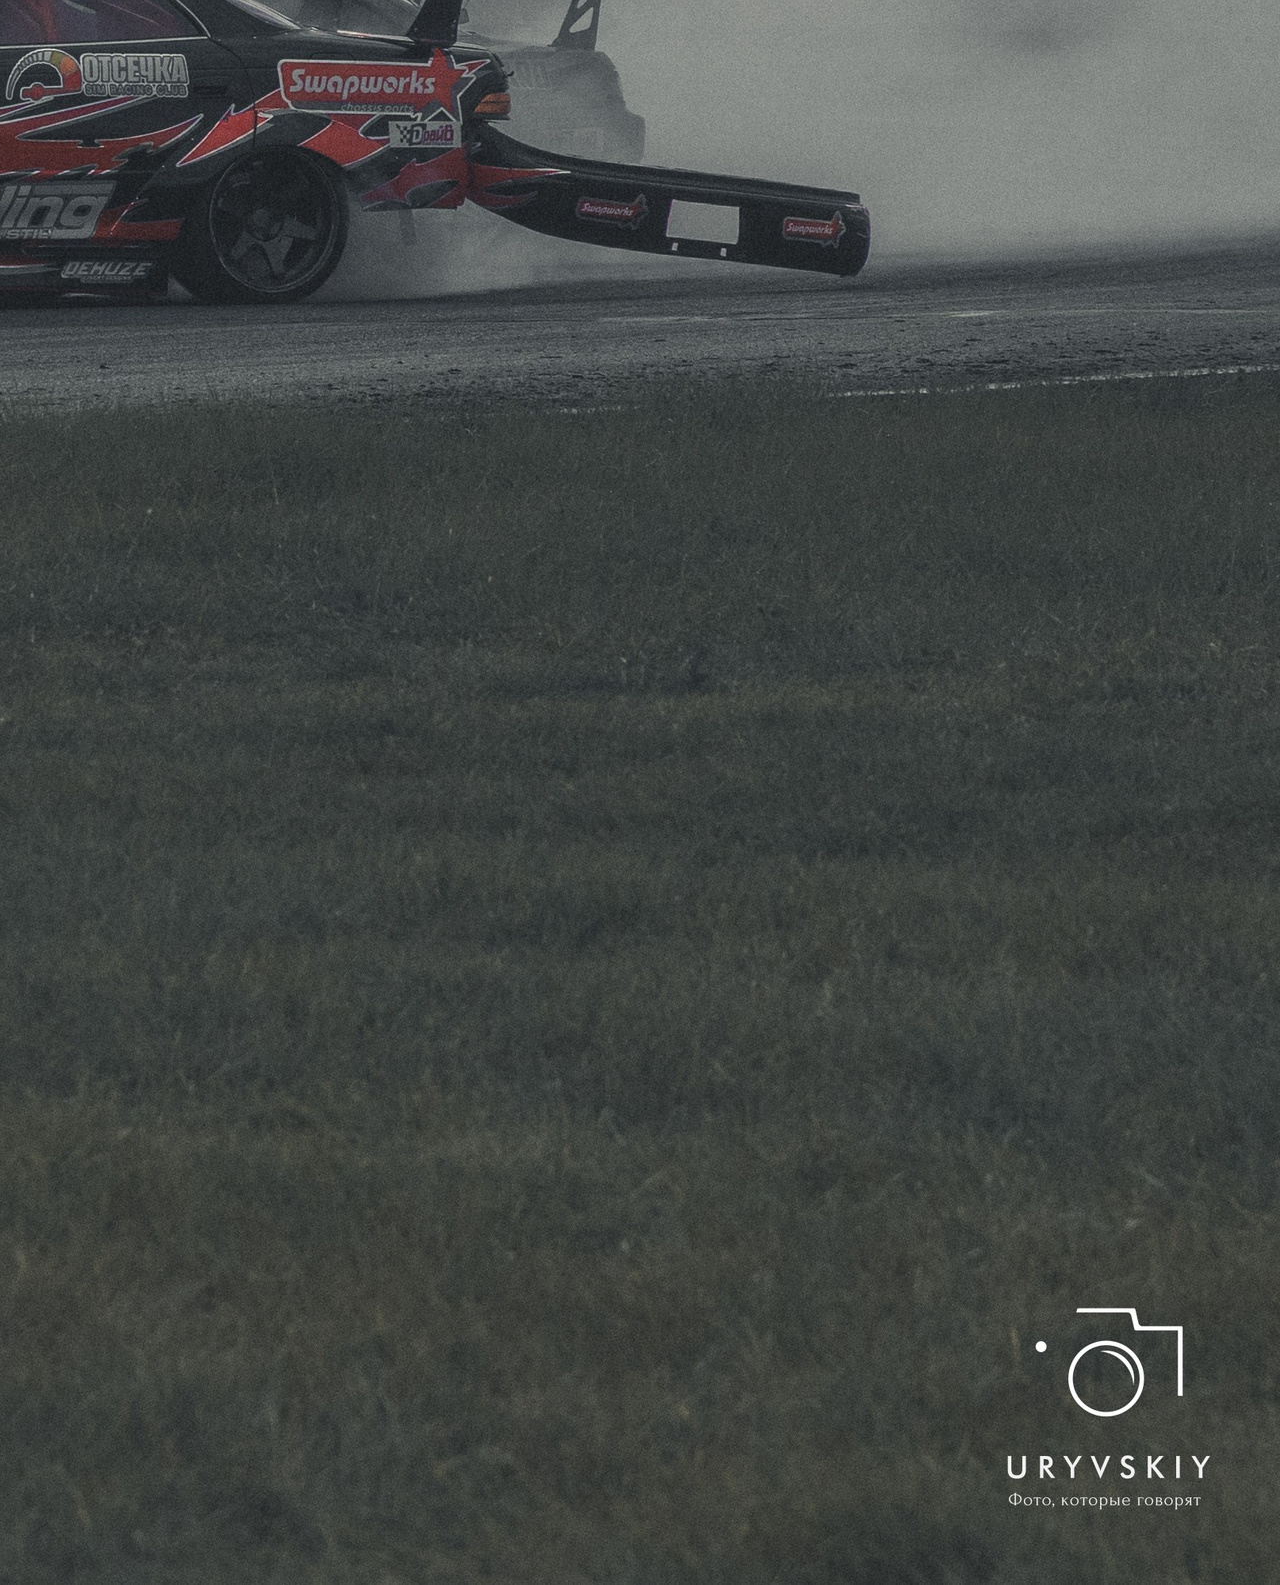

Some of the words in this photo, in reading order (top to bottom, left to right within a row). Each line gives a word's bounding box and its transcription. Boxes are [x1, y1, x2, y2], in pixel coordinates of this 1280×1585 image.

[82, 53, 189, 84] ОТСЕЧКА
[84, 83, 106, 96] SIM
[110, 84, 154, 97] RACING
[156, 84, 188, 97] CLUB
[289, 68, 436, 101] Swapworks
[340, 101, 382, 112] chassis
[384, 103, 415, 114] parts
[580, 202, 635, 216] Swapworks
[785, 221, 834, 235] Swapworks
